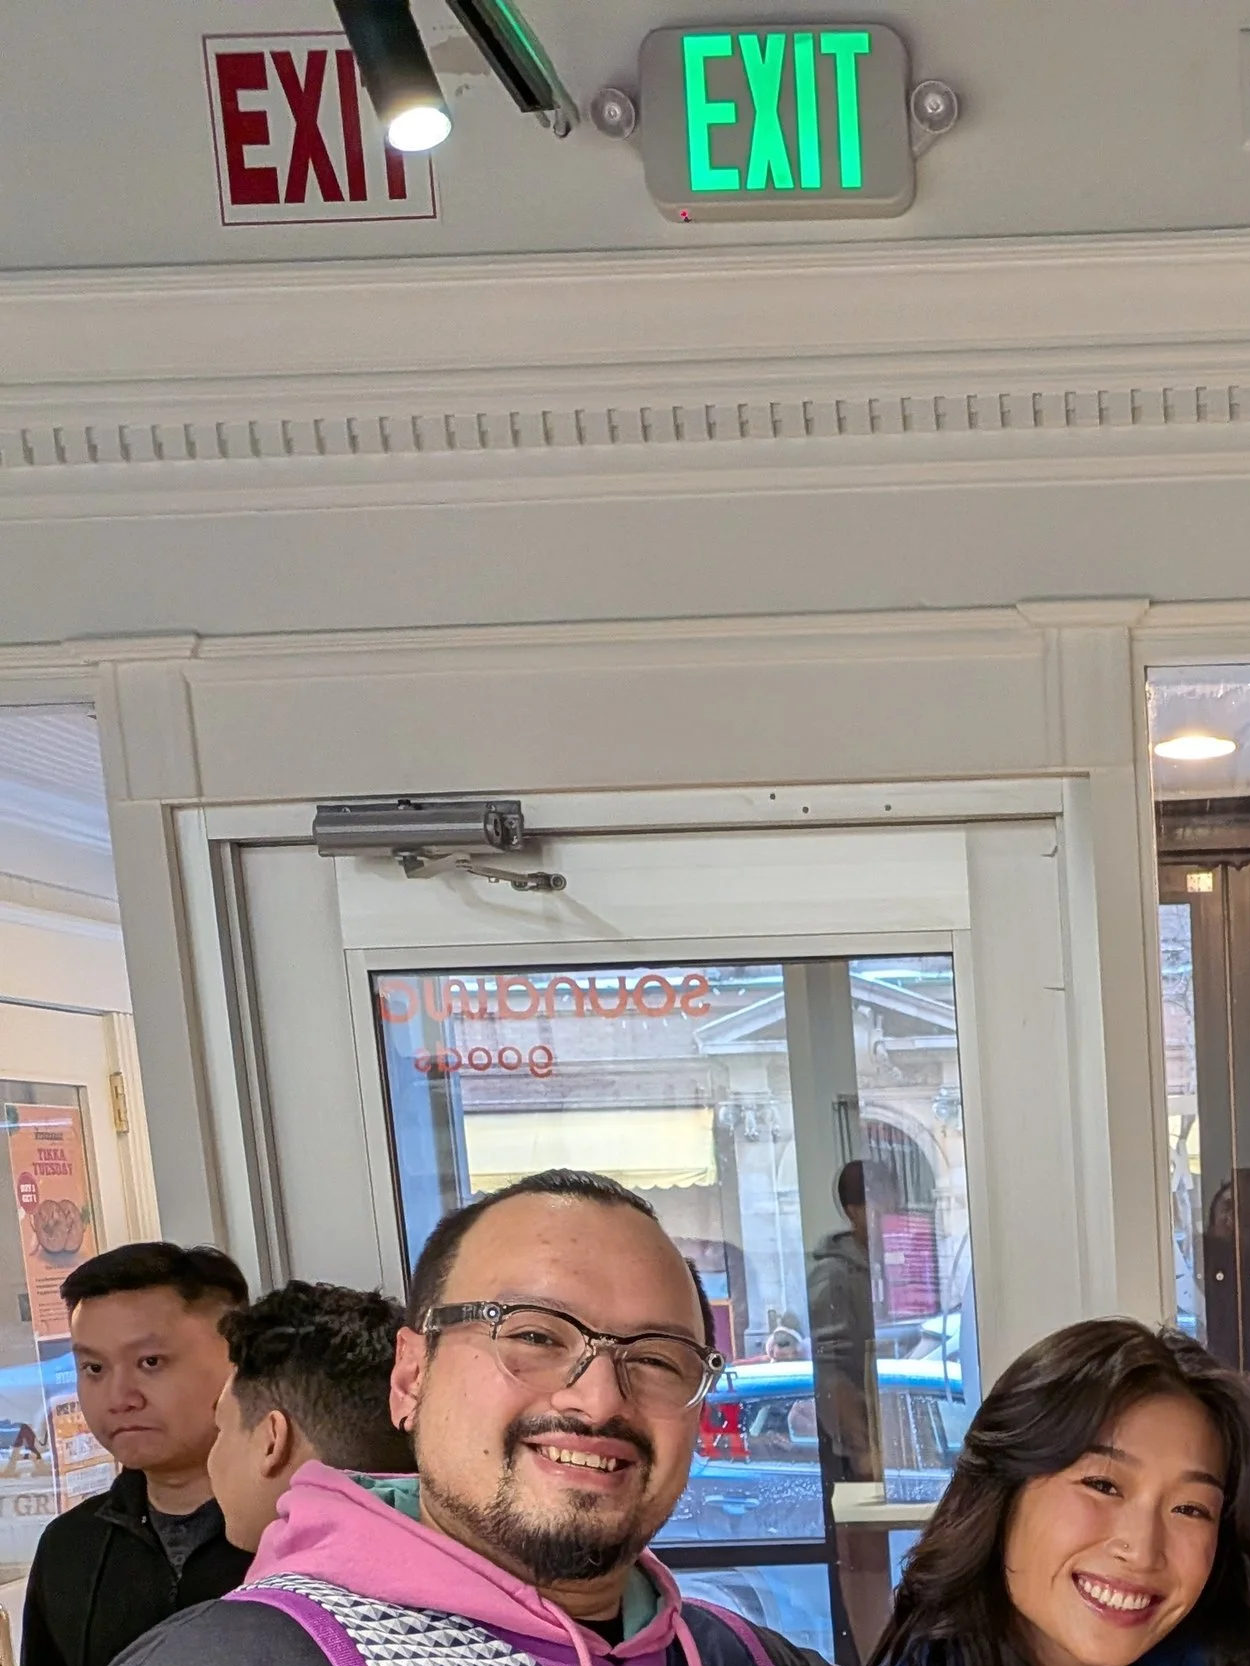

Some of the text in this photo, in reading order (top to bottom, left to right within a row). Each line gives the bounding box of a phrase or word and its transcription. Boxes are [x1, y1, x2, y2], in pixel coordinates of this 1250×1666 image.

[682, 31, 871, 193] EXIT
[37, 1148, 67, 1161] TIKKA
[32, 1161, 73, 1176] TUESDAY
